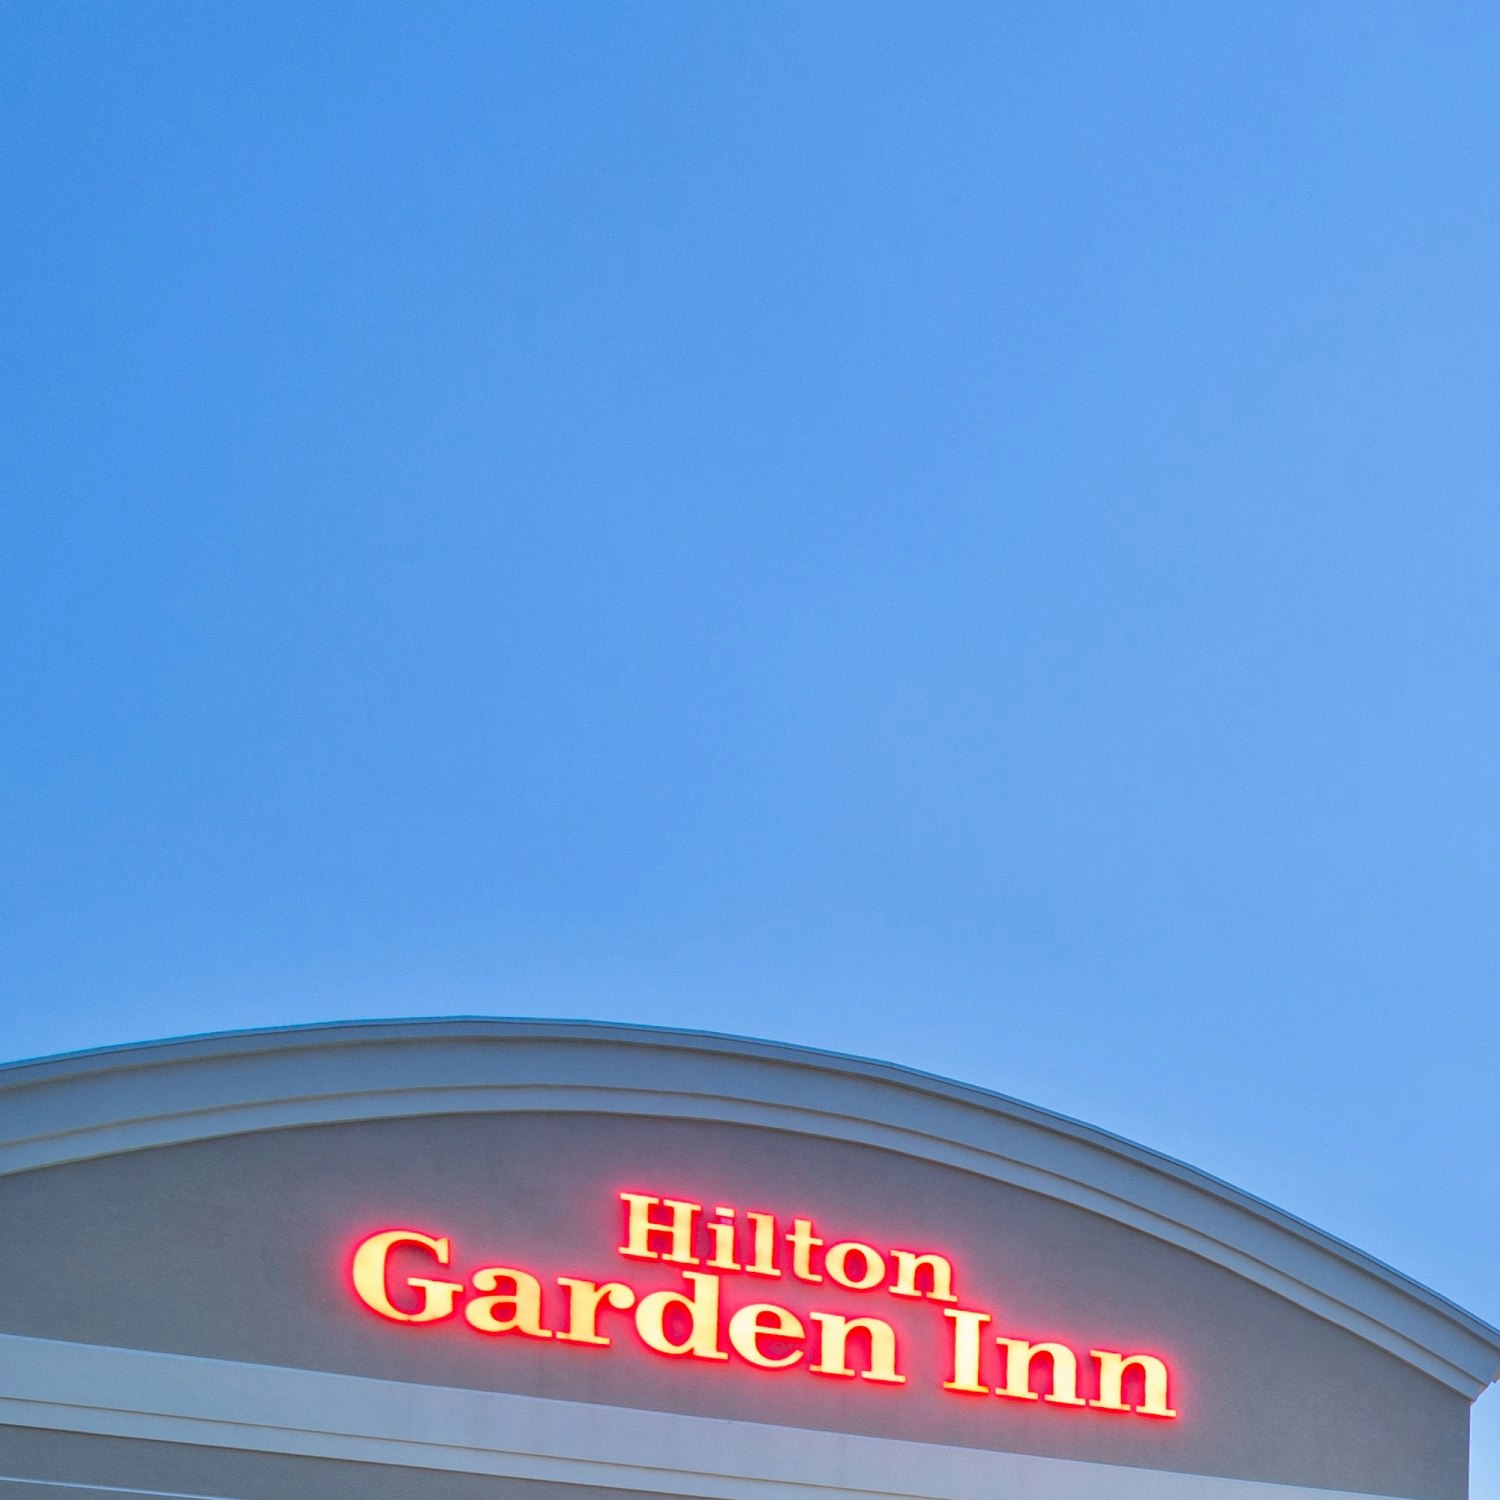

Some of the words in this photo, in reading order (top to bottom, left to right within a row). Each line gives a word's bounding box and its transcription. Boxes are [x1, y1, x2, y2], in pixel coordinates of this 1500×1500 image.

[349, 1227, 908, 1385] Garden
[940, 1305, 1180, 1419] Inn
[617, 1190, 960, 1304] Hilton
